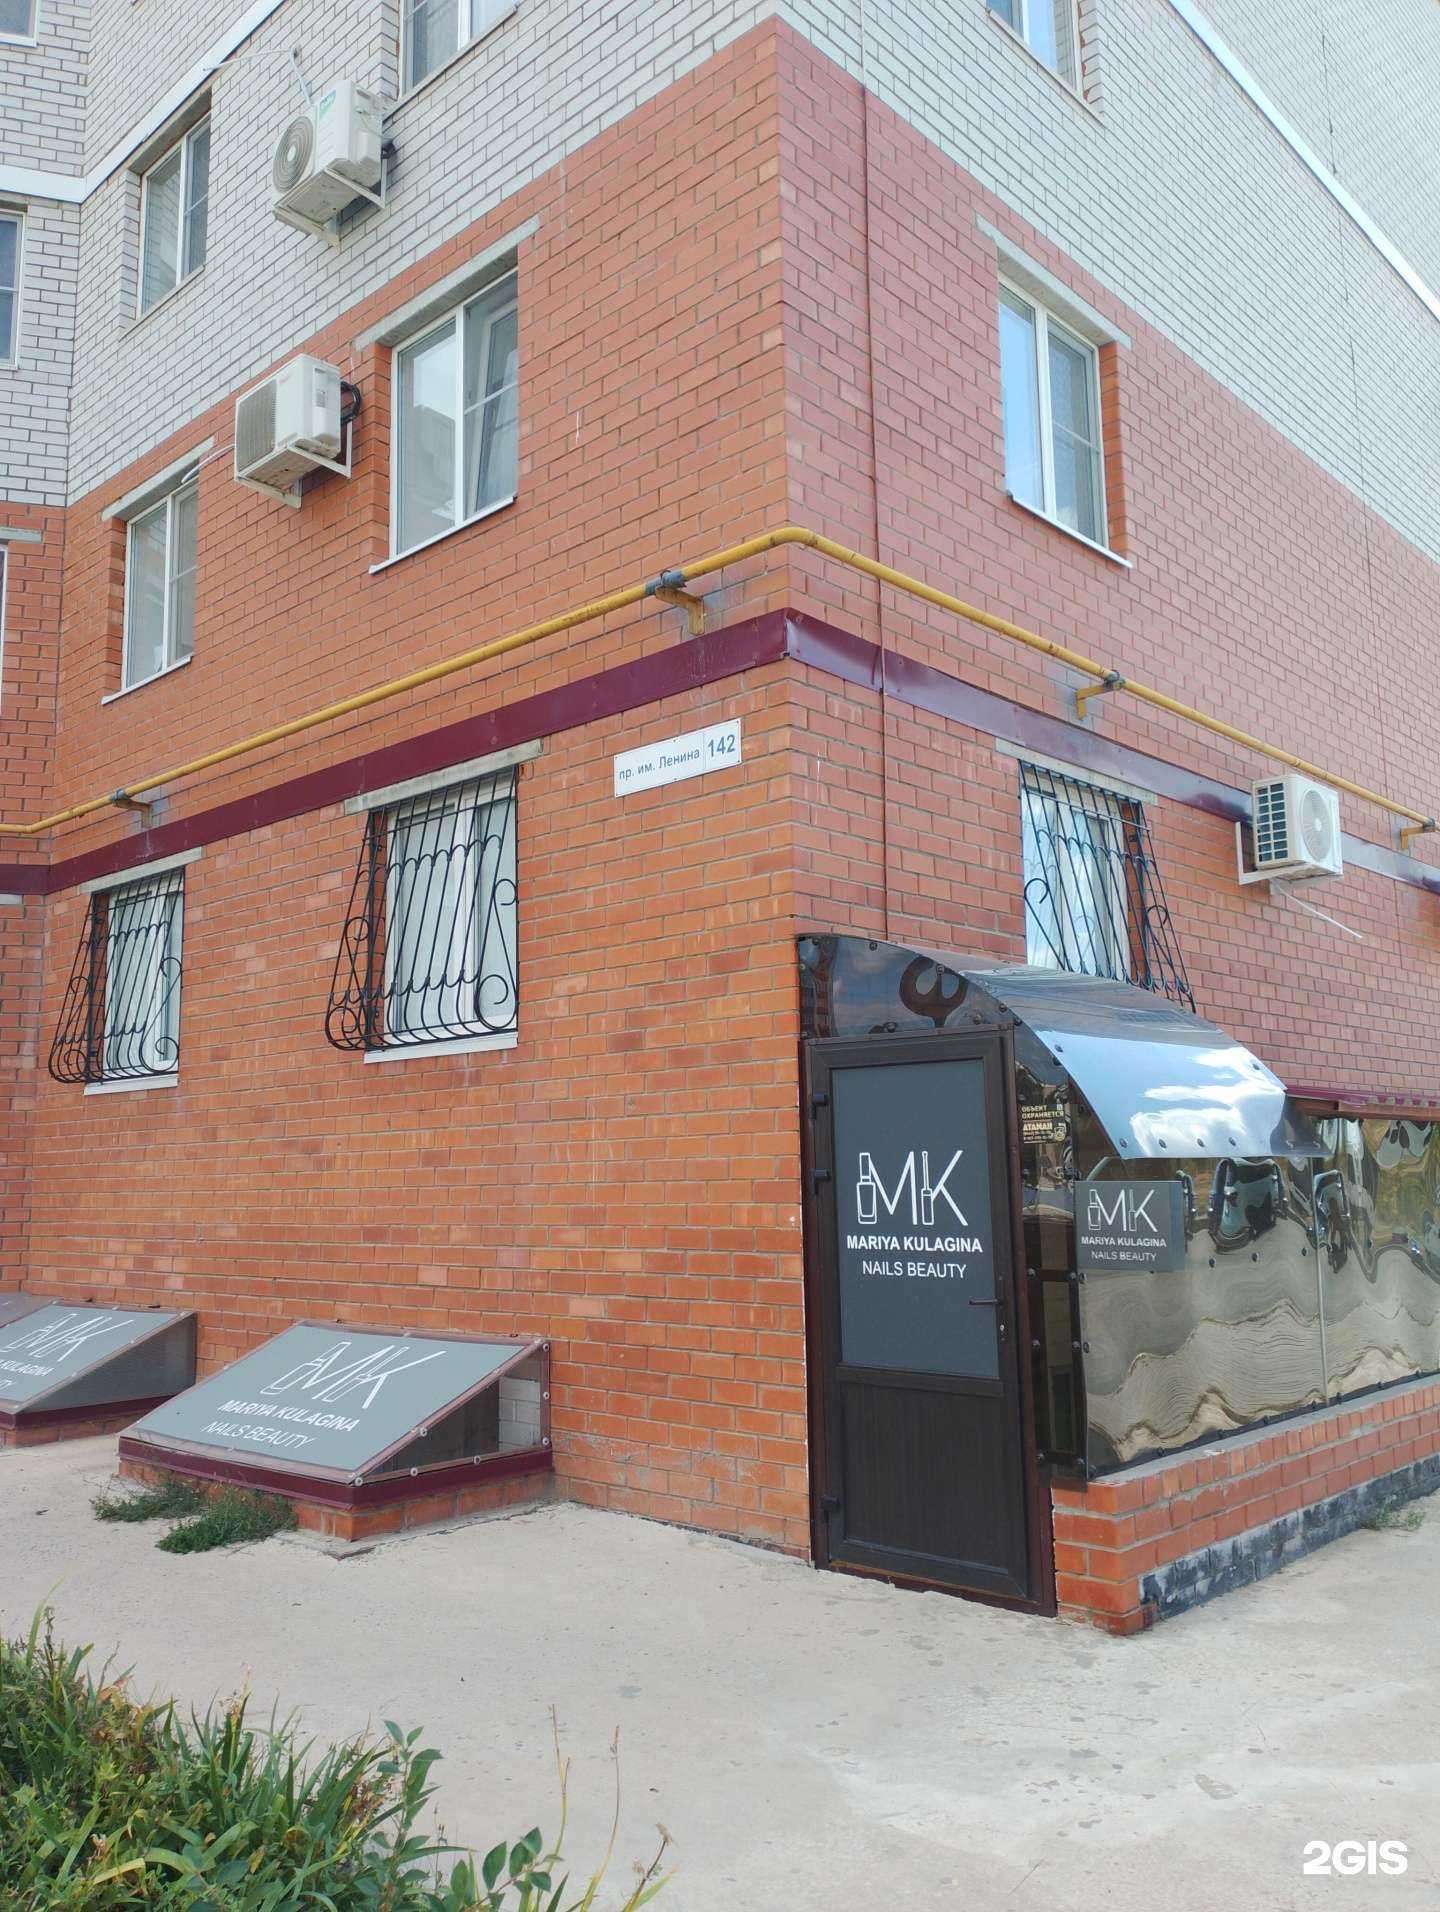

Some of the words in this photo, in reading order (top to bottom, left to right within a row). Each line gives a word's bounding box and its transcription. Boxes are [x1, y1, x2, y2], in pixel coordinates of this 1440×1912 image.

[619, 769, 635, 781] пр.
[637, 762, 656, 775] им.
[658, 748, 701, 769] Ленина
[707, 734, 736, 758] 142
[847, 1235, 900, 1250] MARIYA
[903, 1236, 984, 1252] KULAGINA
[1081, 1236, 1116, 1246] MARIYA
[1117, 1237, 1167, 1248] KULAGINA
[1091, 1250, 1118, 1260] NAILS
[1119, 1251, 1157, 1261] BEAUTY
[862, 1260, 903, 1276] NAILS
[906, 1262, 967, 1278] BEAUTY
[217, 1400, 278, 1416] MARIYA
[274, 1406, 360, 1431] KULAGINA
[200, 1420, 250, 1437] NAILS
[245, 1425, 318, 1448] BEAUTY
